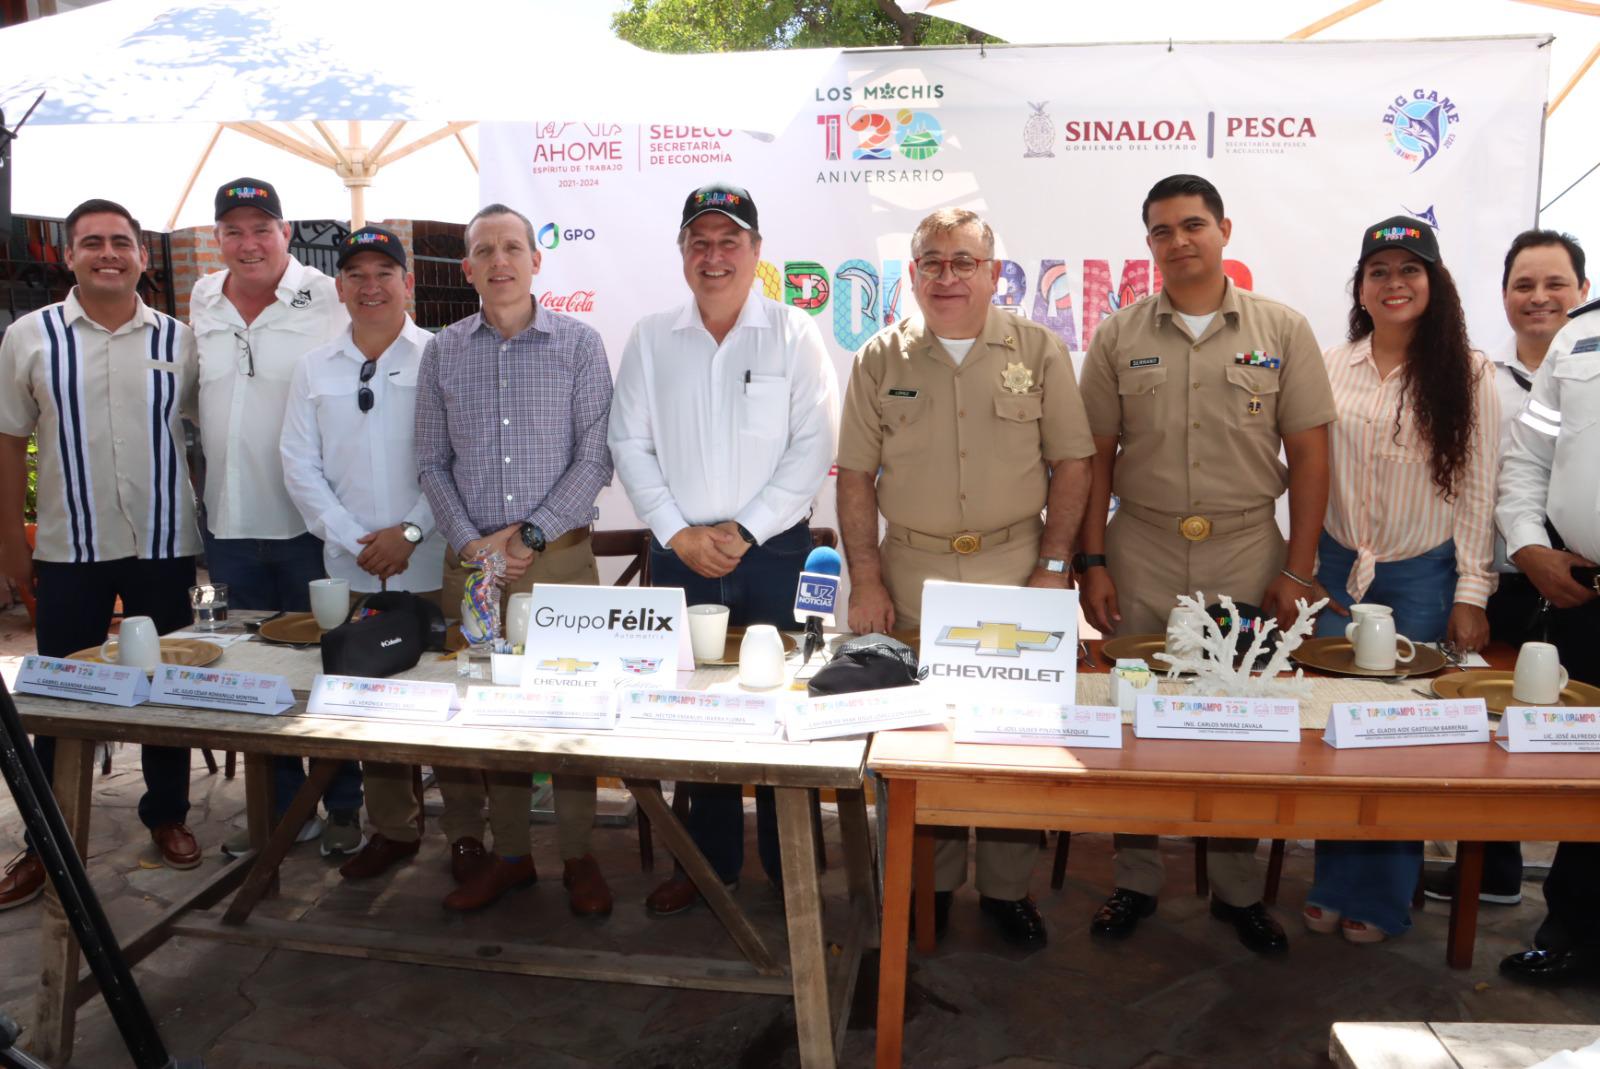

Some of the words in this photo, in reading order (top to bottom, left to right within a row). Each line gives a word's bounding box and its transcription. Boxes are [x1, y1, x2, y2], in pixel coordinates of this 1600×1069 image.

[816, 87, 852, 101] LOS
[1382, 95, 1408, 125] BIG
[1413, 89, 1460, 125] GAME
[1065, 120, 1197, 141] SINALOA
[1227, 117, 1316, 138] PESCA
[533, 141, 622, 162] AHOME
[650, 139, 721, 152] SECRETARÍA
[650, 155, 665, 165] DE
[668, 152, 732, 164] ECONOMÍA
[533, 165, 568, 174] ESPÍRITU
[585, 164, 623, 172] TRABAJO
[816, 169, 944, 183] ANIVERSARIO
[558, 179, 600, 188] 2021-2024
[564, 228, 595, 241] GPO
[800, 582, 835, 600] LUZ
[799, 597, 832, 607] NOTICIAS
[932, 663, 1065, 683] CHEVROLET
[533, 678, 598, 688] CHEVROLET
